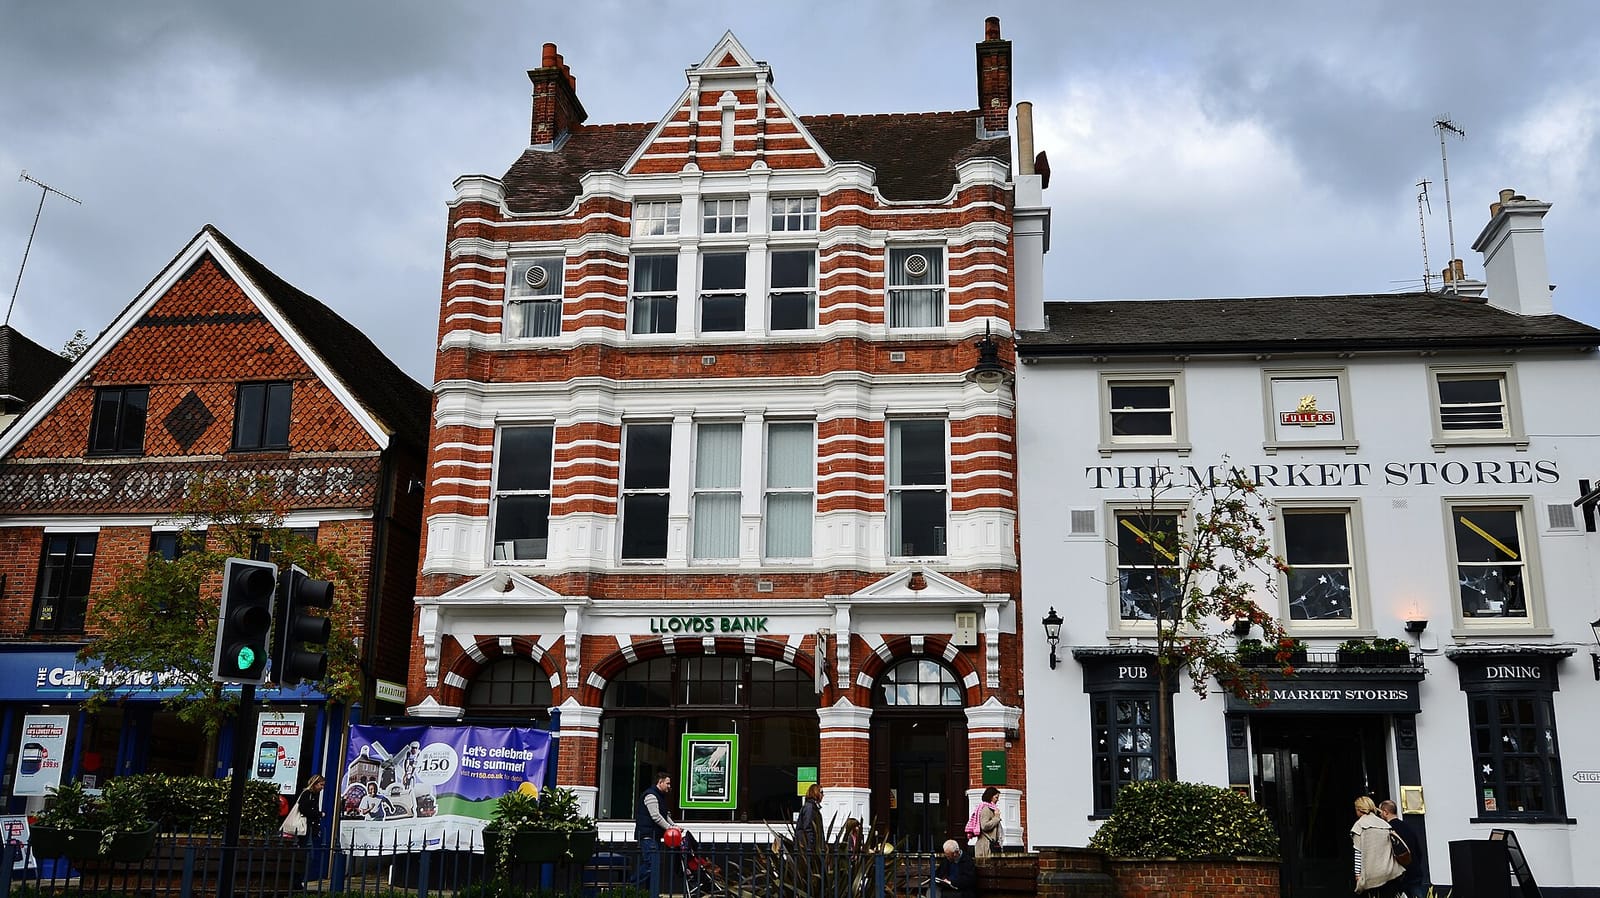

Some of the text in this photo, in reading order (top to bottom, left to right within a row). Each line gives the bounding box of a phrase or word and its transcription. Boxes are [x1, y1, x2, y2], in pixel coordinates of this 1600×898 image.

[1085, 460, 1560, 489] THE MARKET STORES
[650, 617, 768, 632] LLOYDS BANK
[36, 667, 47, 687] THE
[1118, 666, 1147, 678] PUB
[1486, 666, 1540, 678] DINING
[1274, 689, 1341, 700] MARKET
[1345, 689, 1408, 700] STORES
[263, 727, 298, 735] SUPER VALUE
[463, 745, 487, 757] Let's
[489, 748, 533, 760] celebrate
[421, 759, 449, 771] 150
[462, 756, 525, 772] this summer!
